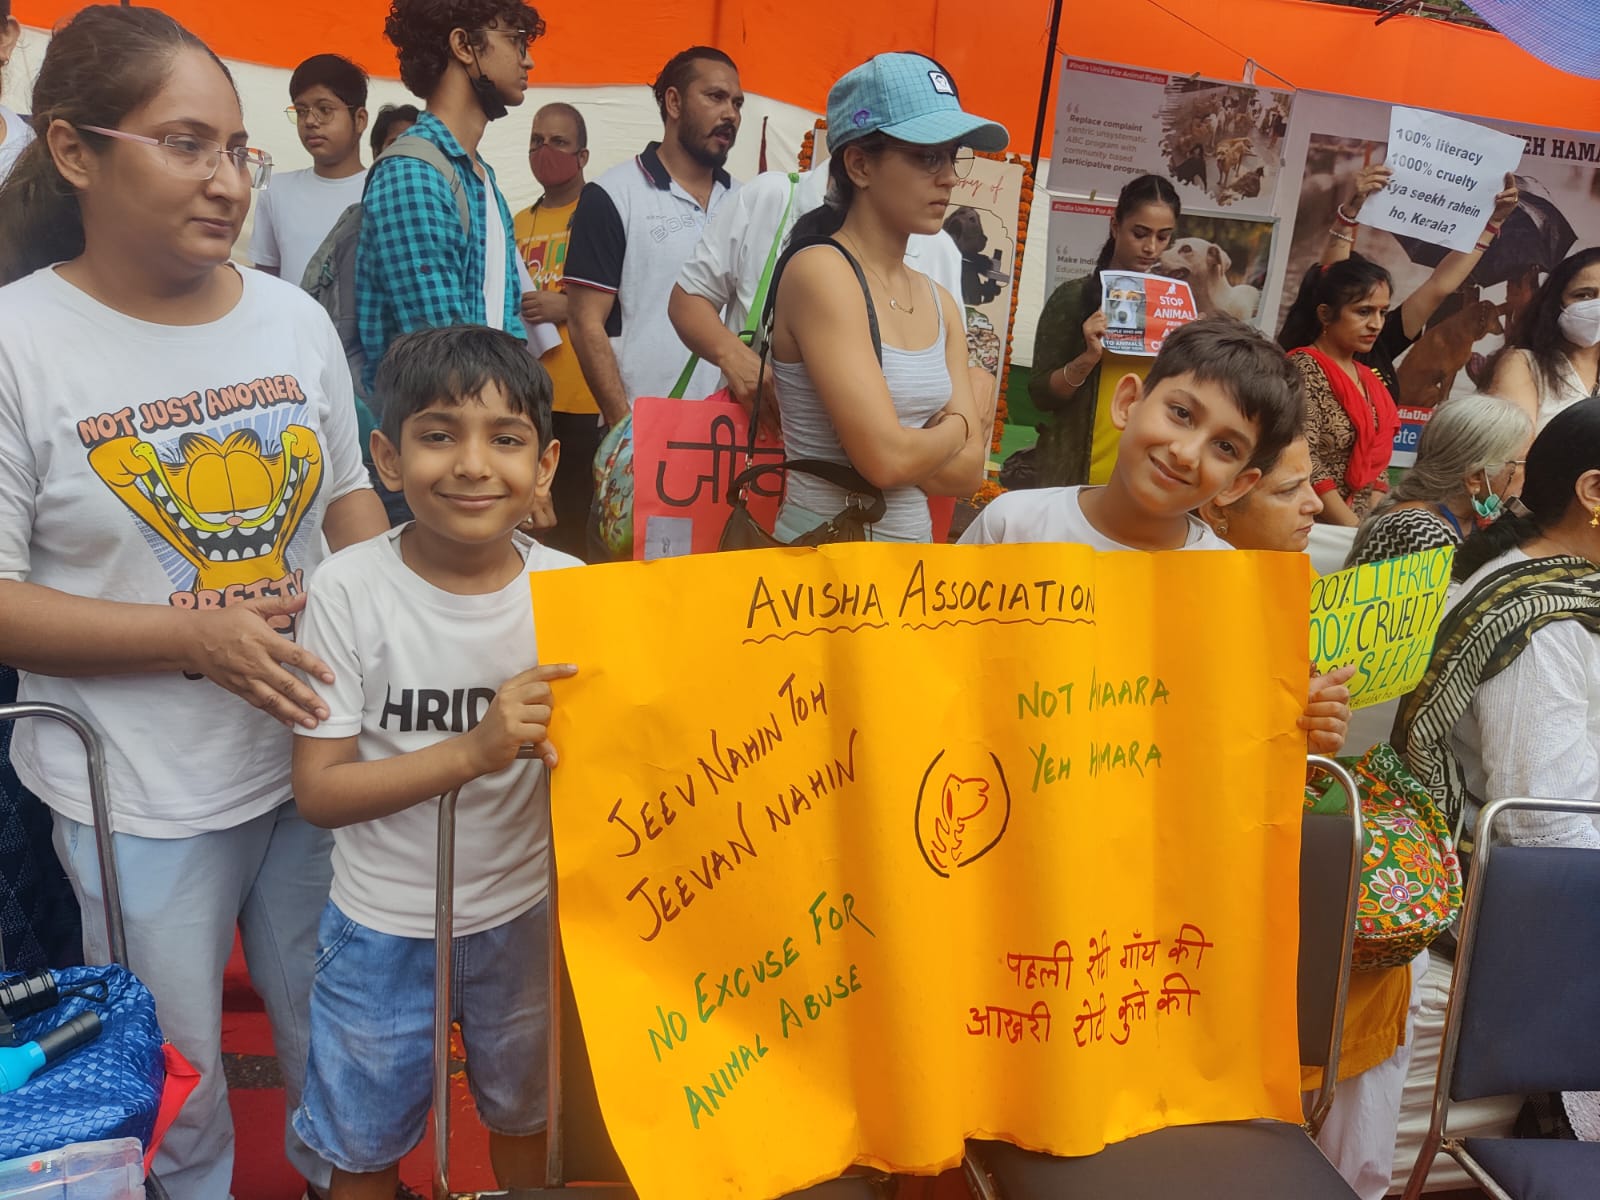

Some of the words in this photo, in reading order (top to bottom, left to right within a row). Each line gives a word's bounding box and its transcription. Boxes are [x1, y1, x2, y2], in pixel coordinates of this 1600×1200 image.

[1070, 114, 1101, 125] Replace
[1103, 119, 1143, 132] complaint
[1062, 157, 1112, 170] participative
[1064, 146, 1108, 159] community
[1109, 152, 1133, 162] based
[1065, 136, 1083, 145] ABC
[1085, 138, 1119, 151] program
[1121, 144, 1137, 152] with
[1396, 128, 1432, 149] 100%
[1435, 138, 1484, 166] literacy
[1391, 152, 1433, 176] 1000%
[1436, 168, 1479, 192] cruelty
[1384, 177, 1408, 196] Kya
[1409, 186, 1447, 207] seekh
[1447, 199, 1481, 218] rahein
[1388, 205, 1408, 223] ho,
[1410, 211, 1457, 236] Kerala?
[1057, 255, 1078, 265] Make
[1154, 307, 1195, 320] ANIMAL
[1160, 295, 1184, 307] STOP
[77, 406, 135, 448] NOT
[139, 391, 204, 433] JUST
[205, 374, 307, 419] ANOTHER
[1393, 428, 1417, 445] ate
[747, 576, 884, 629] AVISHA
[898, 559, 1095, 618] ASSOCIATION
[1310, 571, 1354, 614] 00%
[1354, 546, 1455, 606] LITERACY
[1356, 591, 1449, 652] CRUELTY
[1018, 681, 1074, 720] NOT
[607, 774, 696, 858] JEEV
[697, 711, 783, 795] NAHIN
[778, 672, 828, 727] TOH
[1028, 743, 1071, 793] YEH
[626, 801, 758, 942] JEEVAN
[765, 728, 858, 833] NAHIN
[648, 1005, 688, 1063] NO
[694, 936, 801, 1024] EXCUSE
[808, 891, 877, 945] FOR
[1007, 940, 1074, 991] पहली
[1168, 923, 1214, 970] की
[1156, 972, 1201, 1016] की
[683, 1033, 769, 1130] ANIMAL
[780, 964, 863, 1039] ABUSE
